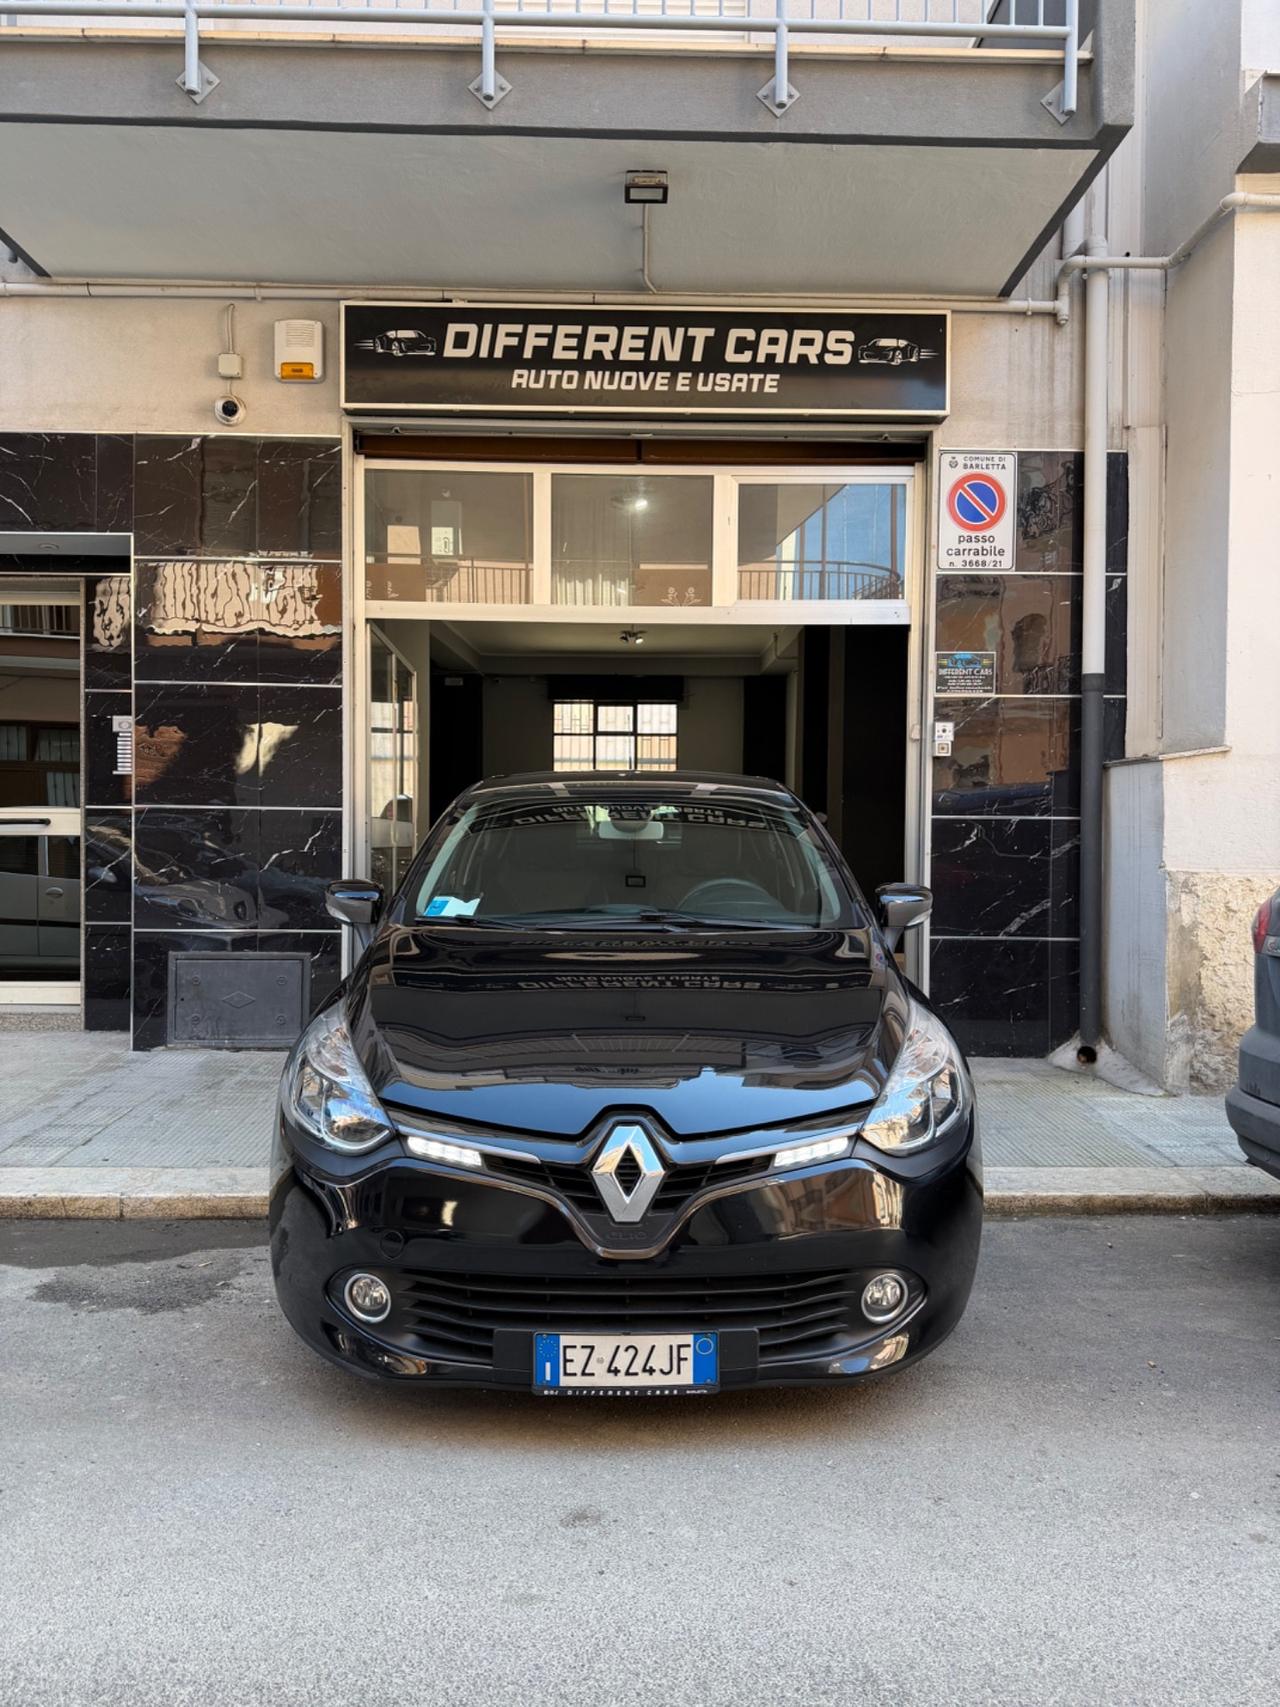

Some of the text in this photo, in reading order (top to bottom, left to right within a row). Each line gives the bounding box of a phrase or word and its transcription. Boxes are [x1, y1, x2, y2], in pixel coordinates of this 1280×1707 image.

[443, 323, 856, 365] DIFFERENT CARS
[511, 369, 780, 393] AUTO NUOVE E USATE
[958, 534, 995, 545] passo
[946, 545, 1006, 556] carrabile
[961, 559, 1003, 568] 3668/21
[562, 1344, 691, 1377] EZ 424JF
